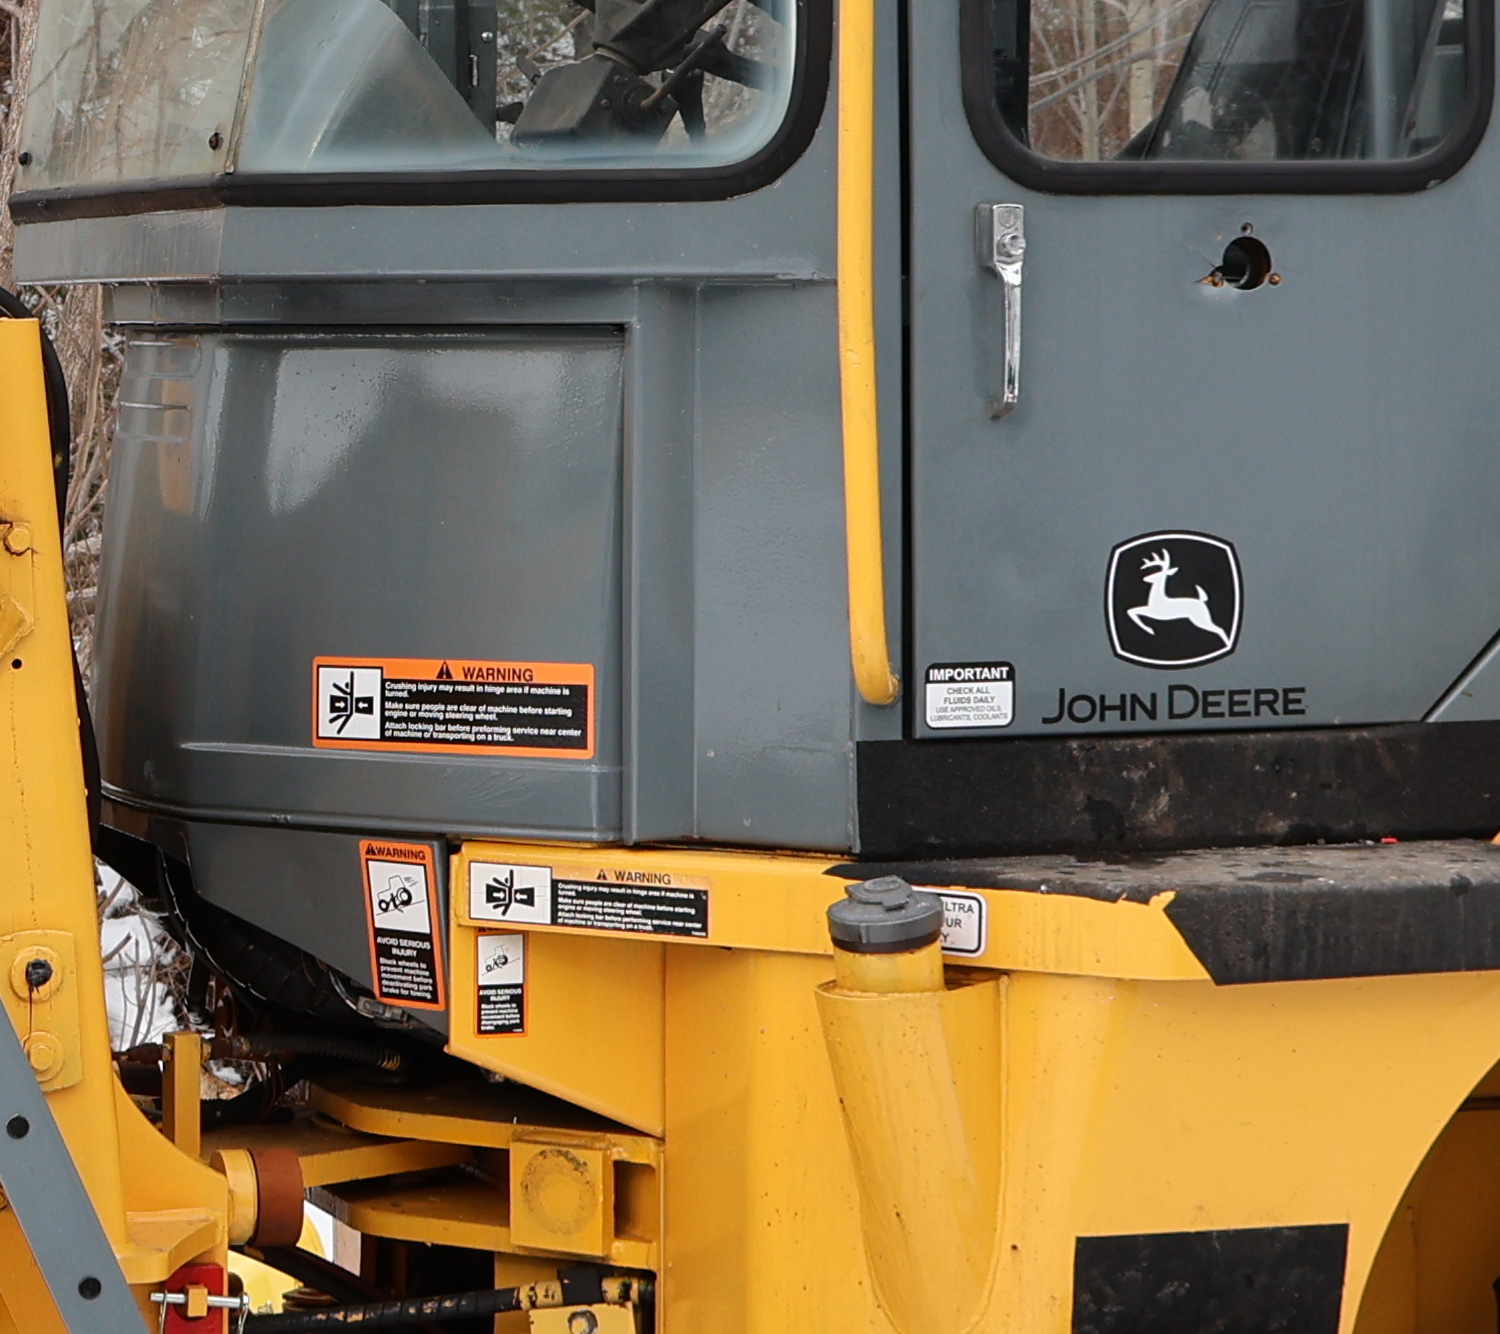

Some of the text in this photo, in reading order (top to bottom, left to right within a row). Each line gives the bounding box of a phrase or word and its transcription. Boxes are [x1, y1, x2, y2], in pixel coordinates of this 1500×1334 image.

[462, 667, 533, 682] WARNING
[929, 667, 1009, 681] IMPORTANT
[385, 682, 416, 692] Crushing
[418, 683, 437, 693] injury
[438, 685, 453, 693] may
[455, 684, 475, 692] result
[484, 685, 505, 695] hinge
[524, 686, 529, 694] if
[530, 687, 561, 695] machine
[976, 686, 990, 694] ALL
[944, 696, 971, 704] FLUIDS
[1042, 684, 1306, 724] JOHN DEERE
[385, 711, 408, 719] engine
[418, 712, 444, 720] moving
[445, 713, 474, 721] steering
[421, 703, 445, 713] people
[459, 704, 477, 712] clear
[487, 705, 518, 713] machine
[519, 706, 543, 714] before
[544, 707, 572, 717] starting
[973, 712, 1008, 720] COOLANTS
[408, 723, 433, 732] locking
[432, 732, 475, 742] transporting
[375, 847, 426, 860] WARNING
[614, 870, 672, 885] WARNING
[944, 901, 975, 914] LTRA
